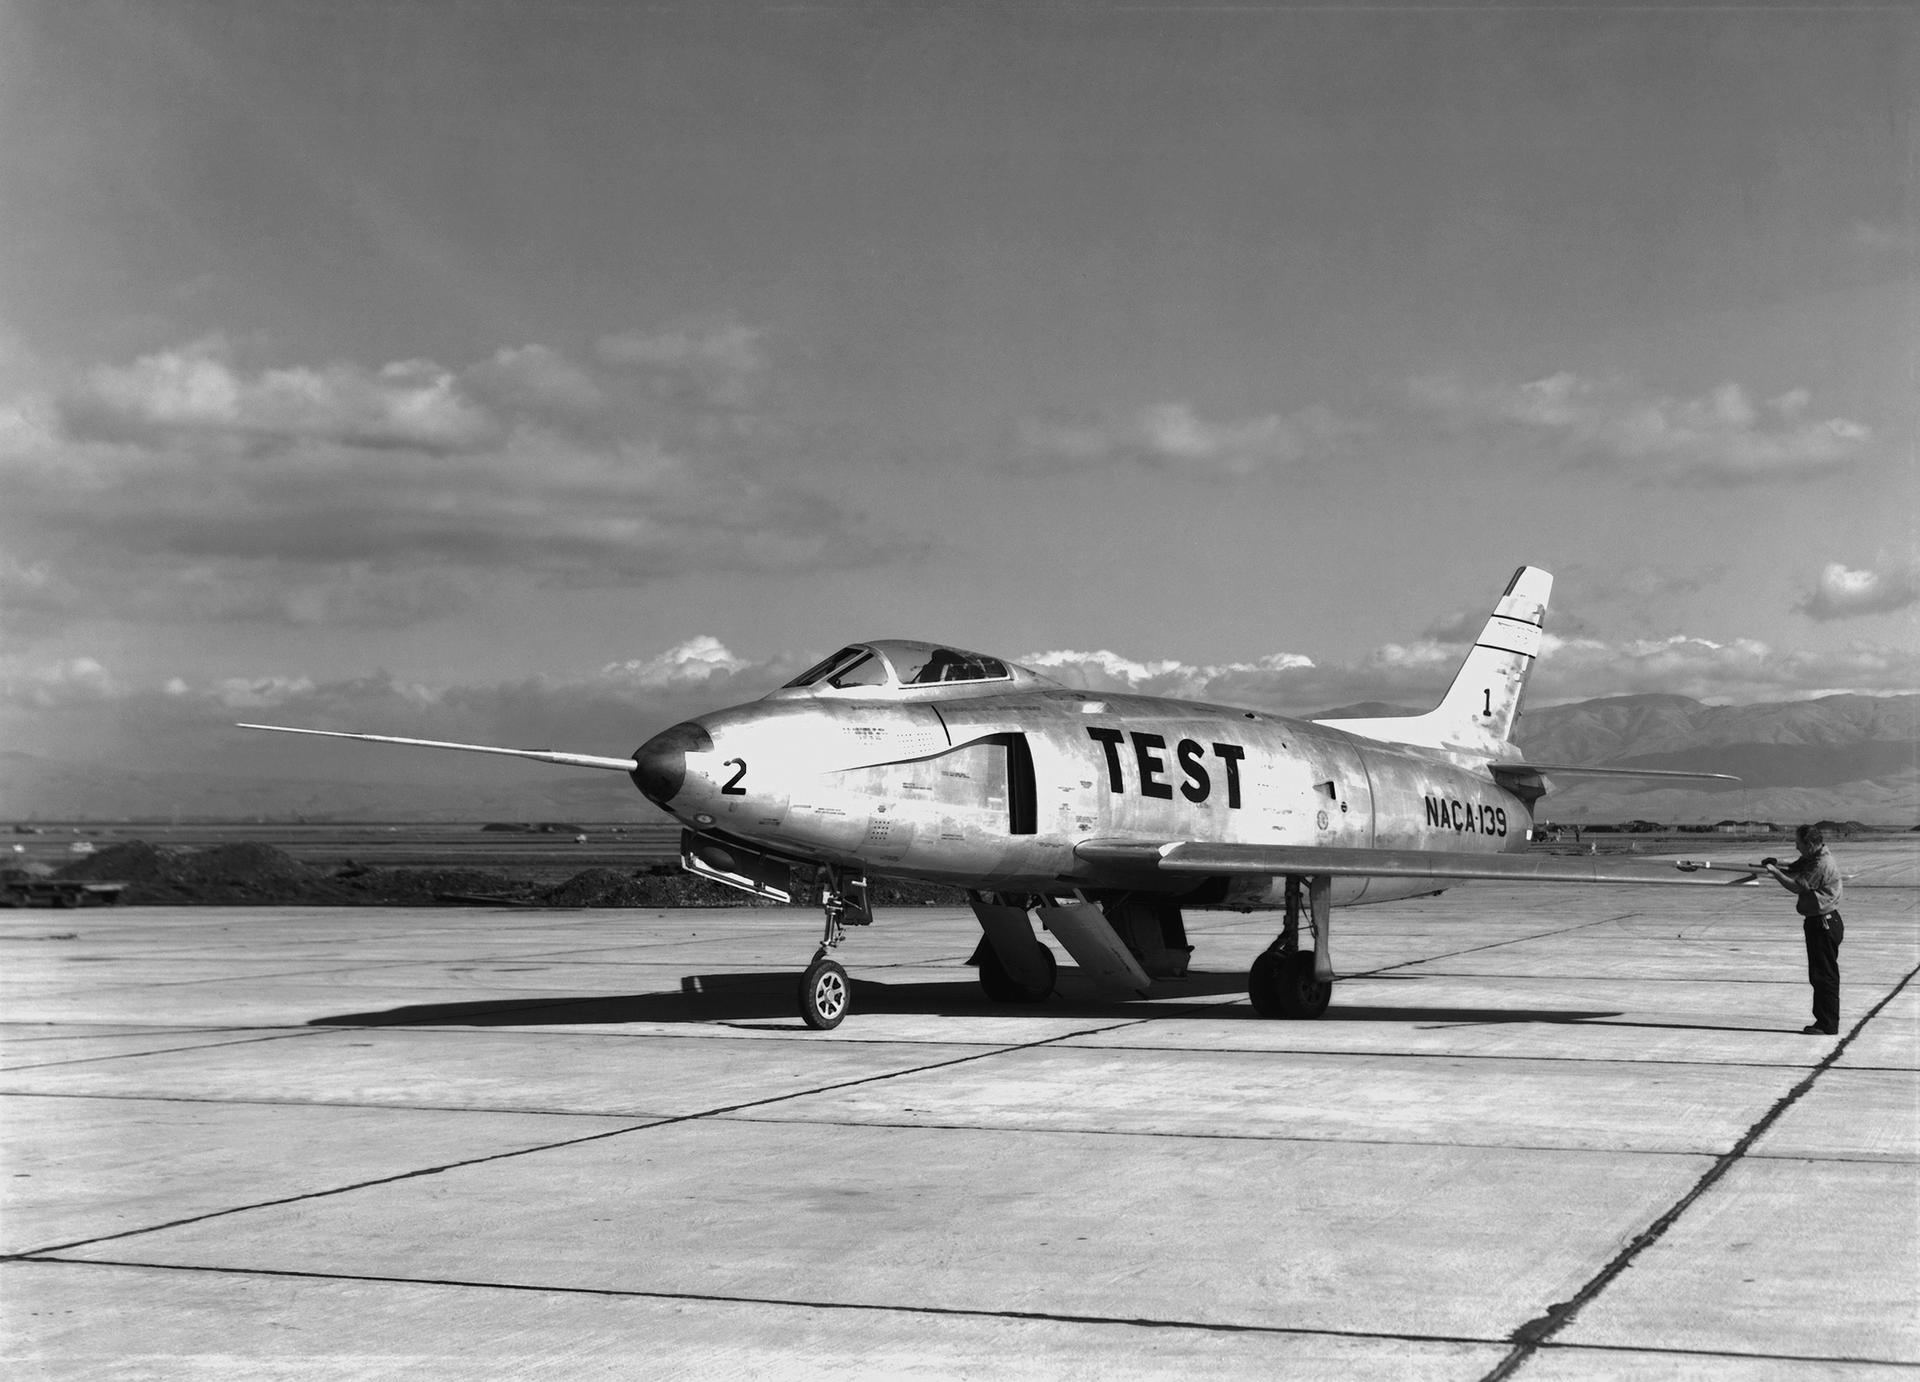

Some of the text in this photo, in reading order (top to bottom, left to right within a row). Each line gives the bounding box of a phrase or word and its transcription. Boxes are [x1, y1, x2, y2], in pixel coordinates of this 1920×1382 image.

[1483, 688, 1492, 717] 1
[721, 757, 747, 796] 2
[1085, 726, 1245, 809] TEST
